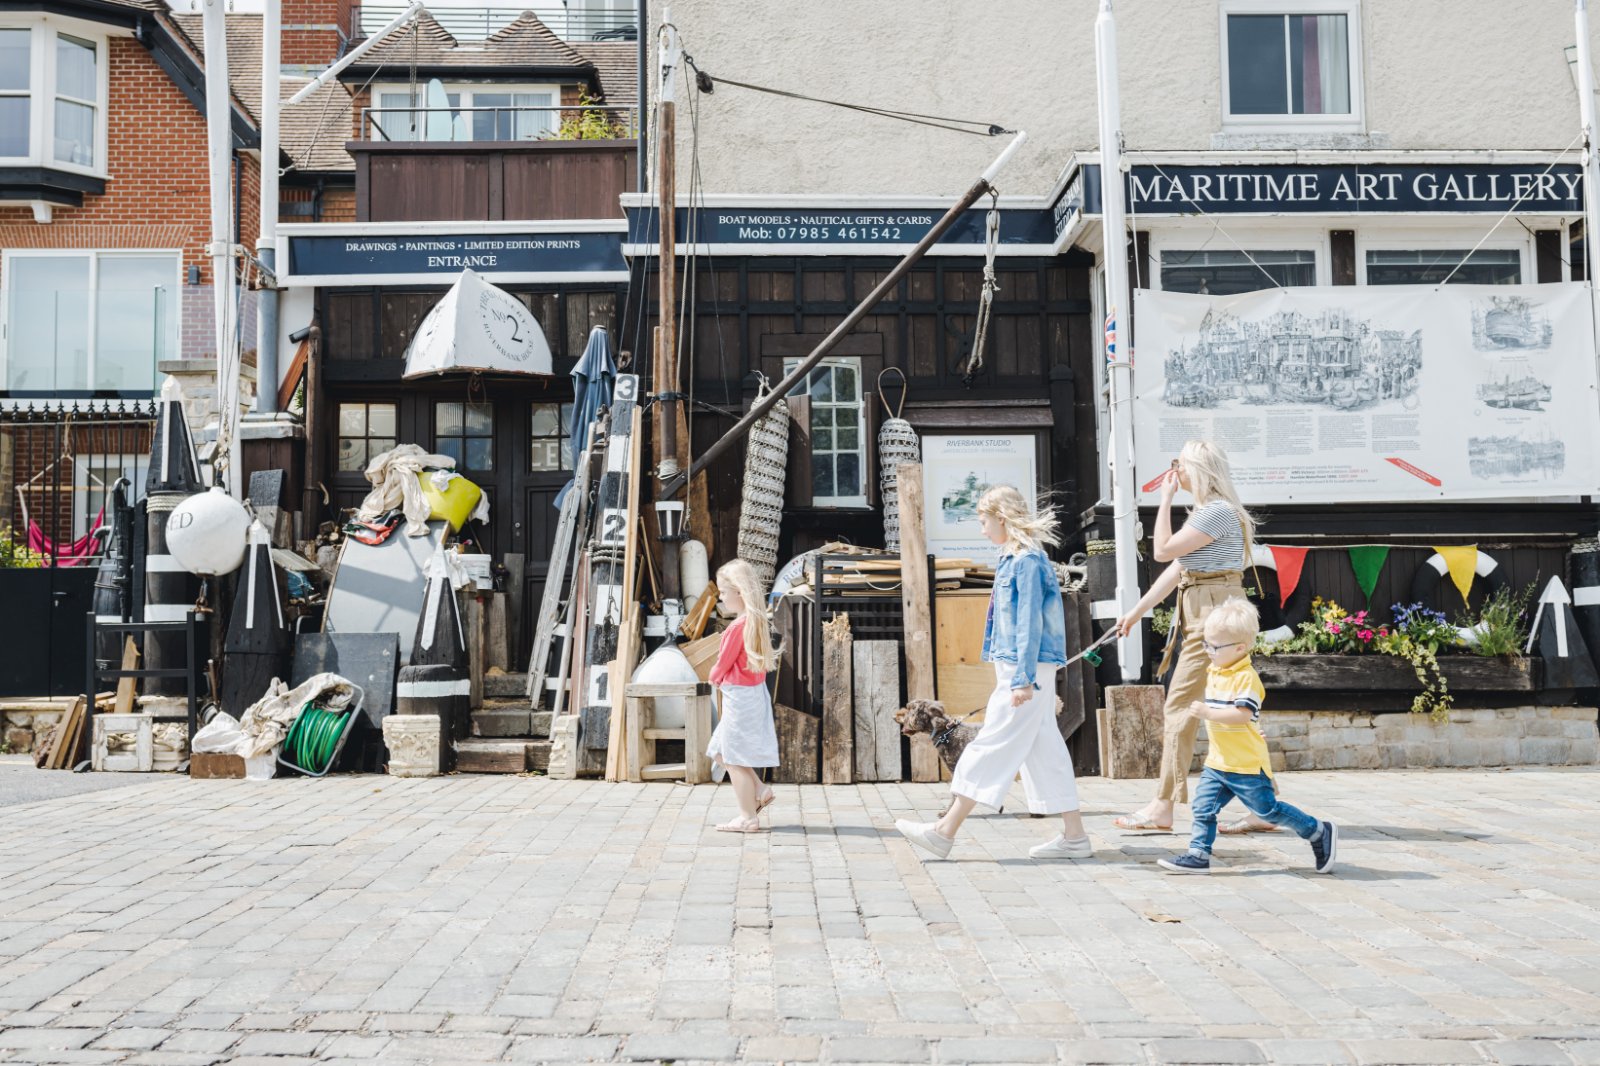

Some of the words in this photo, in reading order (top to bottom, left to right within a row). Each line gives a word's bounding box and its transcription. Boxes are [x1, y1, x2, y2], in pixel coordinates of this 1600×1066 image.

[1131, 173, 1321, 203] MARITIME
[1331, 172, 1403, 202] ART
[1412, 172, 1584, 202] GALLERY
[718, 215, 747, 225] BOAT
[748, 215, 791, 225] MODELS
[800, 216, 854, 225] NAUTICAL
[855, 216, 885, 225] GIFTS
[886, 216, 895, 225] &
[896, 216, 932, 225] CARDS
[739, 227, 772, 239] Mob:
[777, 227, 830, 239] 07985
[837, 227, 901, 239] 461542
[345, 242, 397, 252] DRAWINGS
[405, 242, 456, 251] PAINTINGS
[464, 241, 505, 250] LIMITED
[506, 241, 545, 250] EDITION
[546, 240, 581, 249] PRINTS
[427, 255, 498, 268] ENTRANCE
[506, 314, 524, 344] 2
[617, 374, 637, 400] 3
[946, 439, 984, 447] RIVERBANK
[984, 439, 1012, 447] STUDIO
[604, 514, 626, 541] 2
[595, 672, 609, 701] 1
